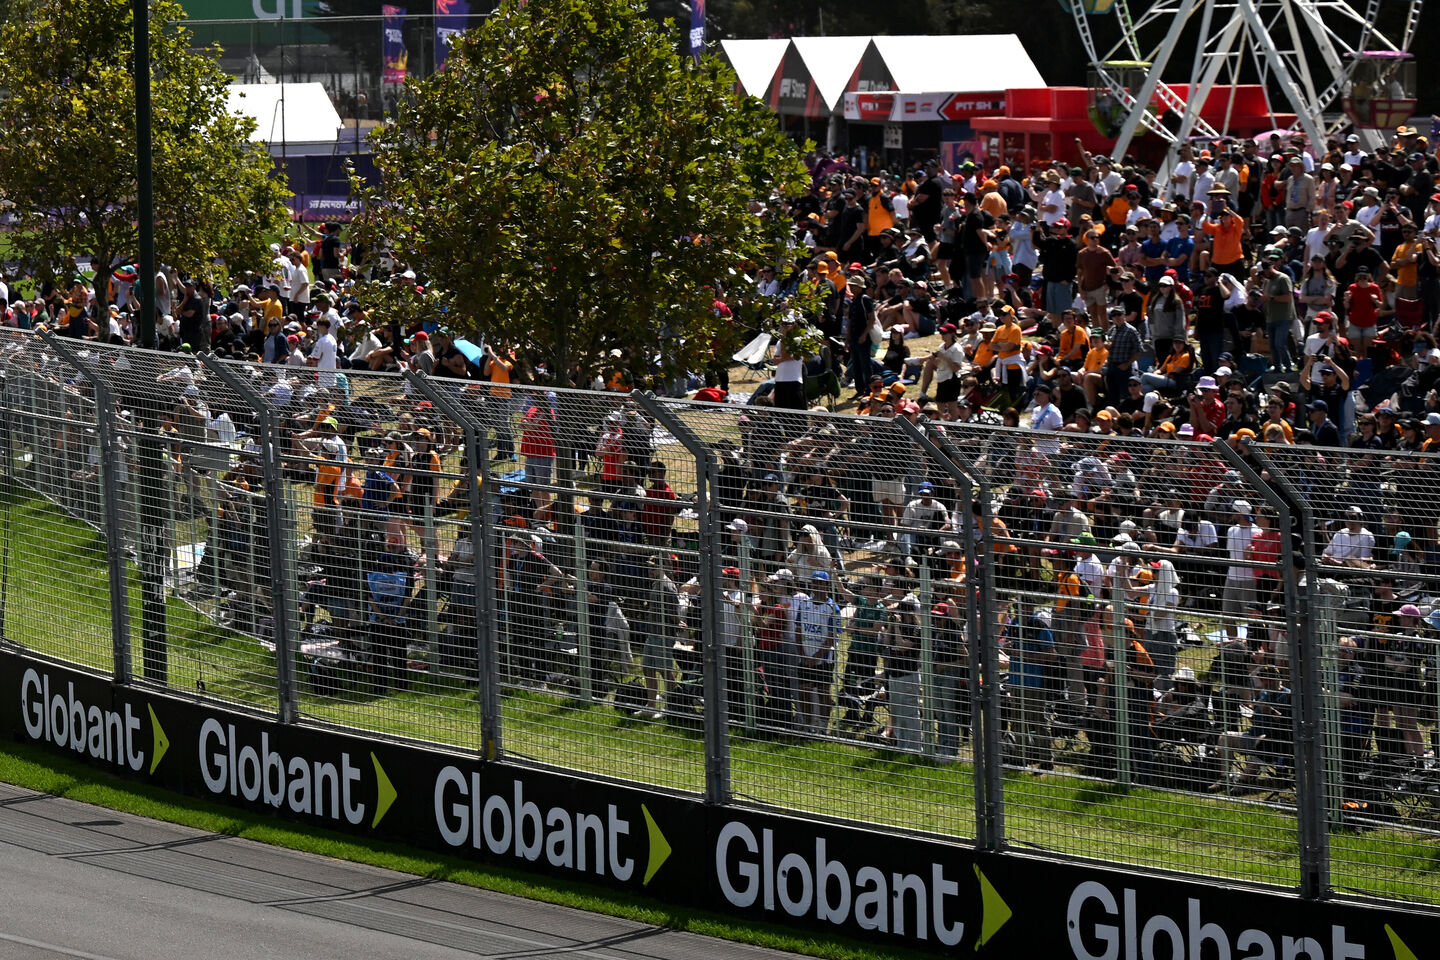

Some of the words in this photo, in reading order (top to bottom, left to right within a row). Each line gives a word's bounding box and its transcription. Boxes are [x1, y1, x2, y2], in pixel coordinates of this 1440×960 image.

[955, 101, 975, 111] PIT
[20, 667, 144, 772] Globant
[198, 717, 365, 825] Globant
[433, 765, 635, 881] Globant
[715, 821, 964, 946] Globant
